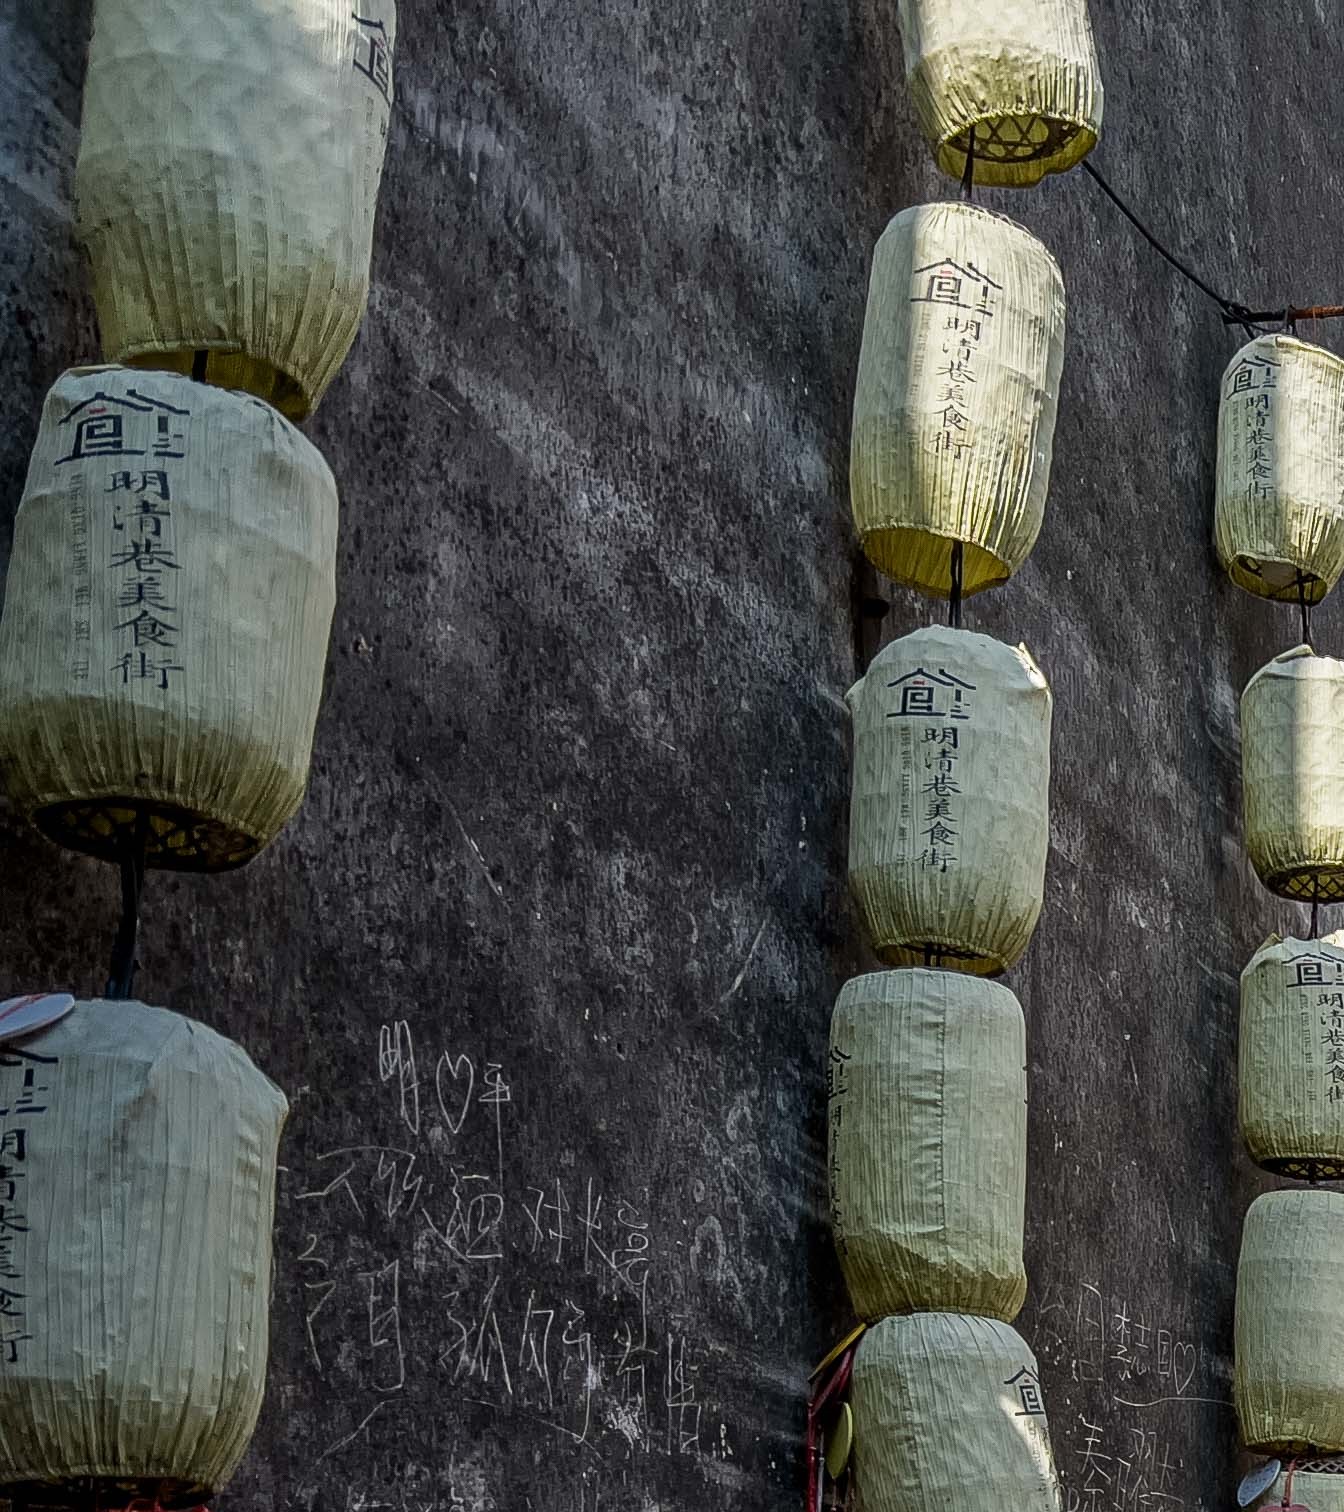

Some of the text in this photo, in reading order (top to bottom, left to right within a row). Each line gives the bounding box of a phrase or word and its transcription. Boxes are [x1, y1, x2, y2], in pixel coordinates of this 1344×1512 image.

[929, 316, 981, 460] 明清巷美食街
[1244, 393, 1274, 502] 明清巷美食街
[105, 469, 185, 690] 明清巷美食街
[914, 726, 962, 873] 明清巷美食街
